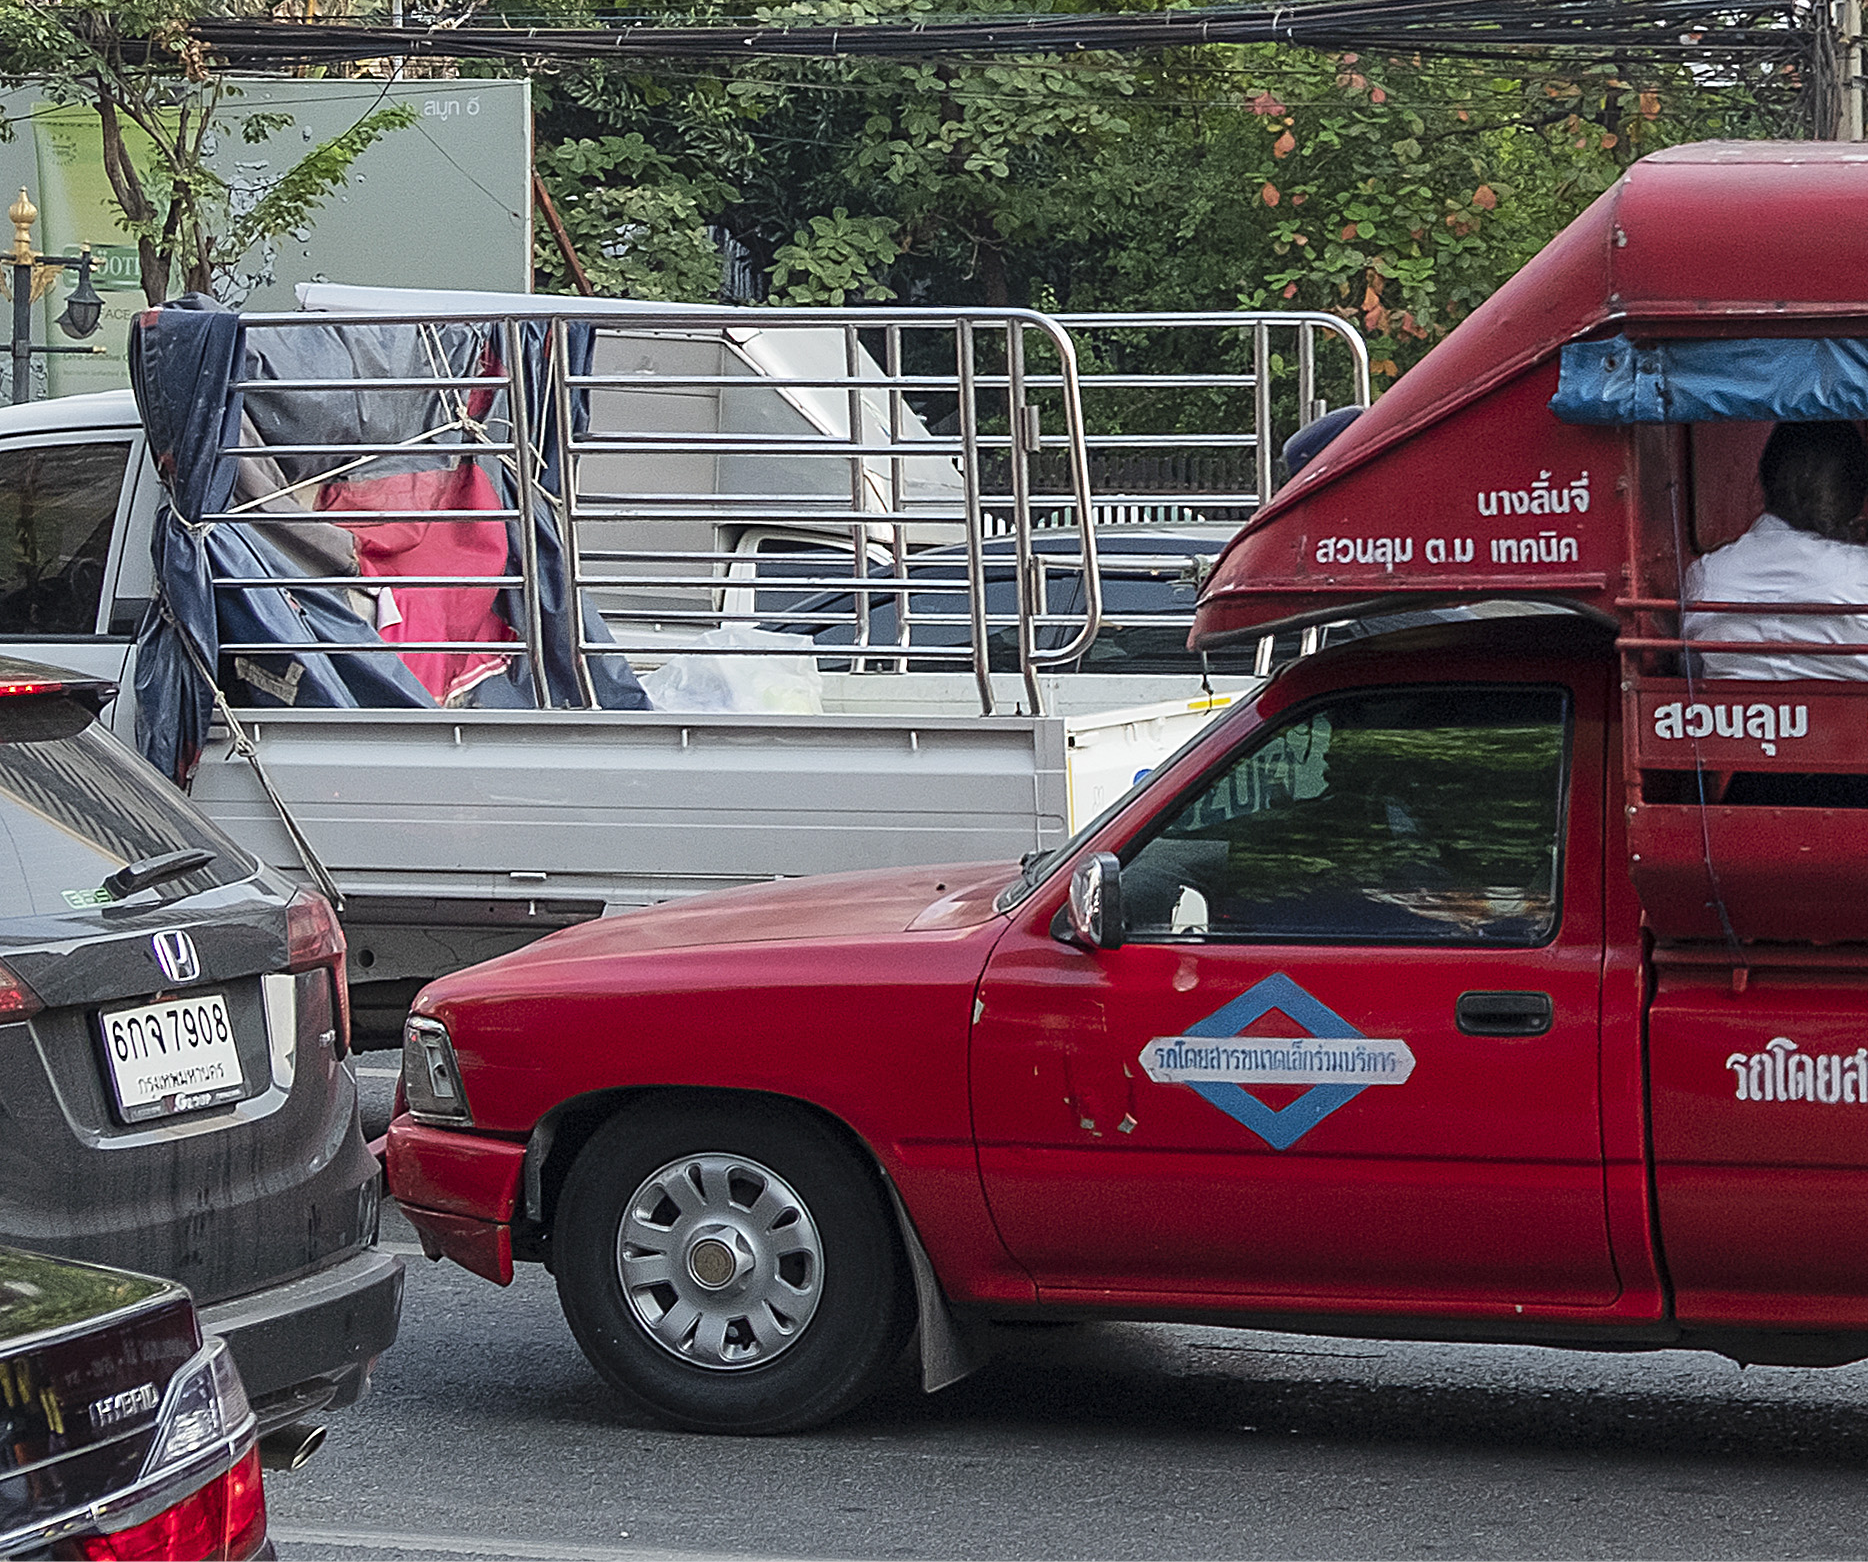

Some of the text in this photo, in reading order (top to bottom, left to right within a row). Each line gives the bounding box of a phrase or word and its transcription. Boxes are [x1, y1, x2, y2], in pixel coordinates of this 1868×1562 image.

[1478, 470, 1590, 516] นางลิ้นจี่
[1316, 537, 1413, 574] สวนลุม
[1491, 531, 1579, 563] เทคนิค
[1654, 701, 1809, 755] สวนลุม
[112, 1003, 228, 1062] 6กจ 7908
[138, 1062, 225, 1099] กรุงเทพมหานคร
